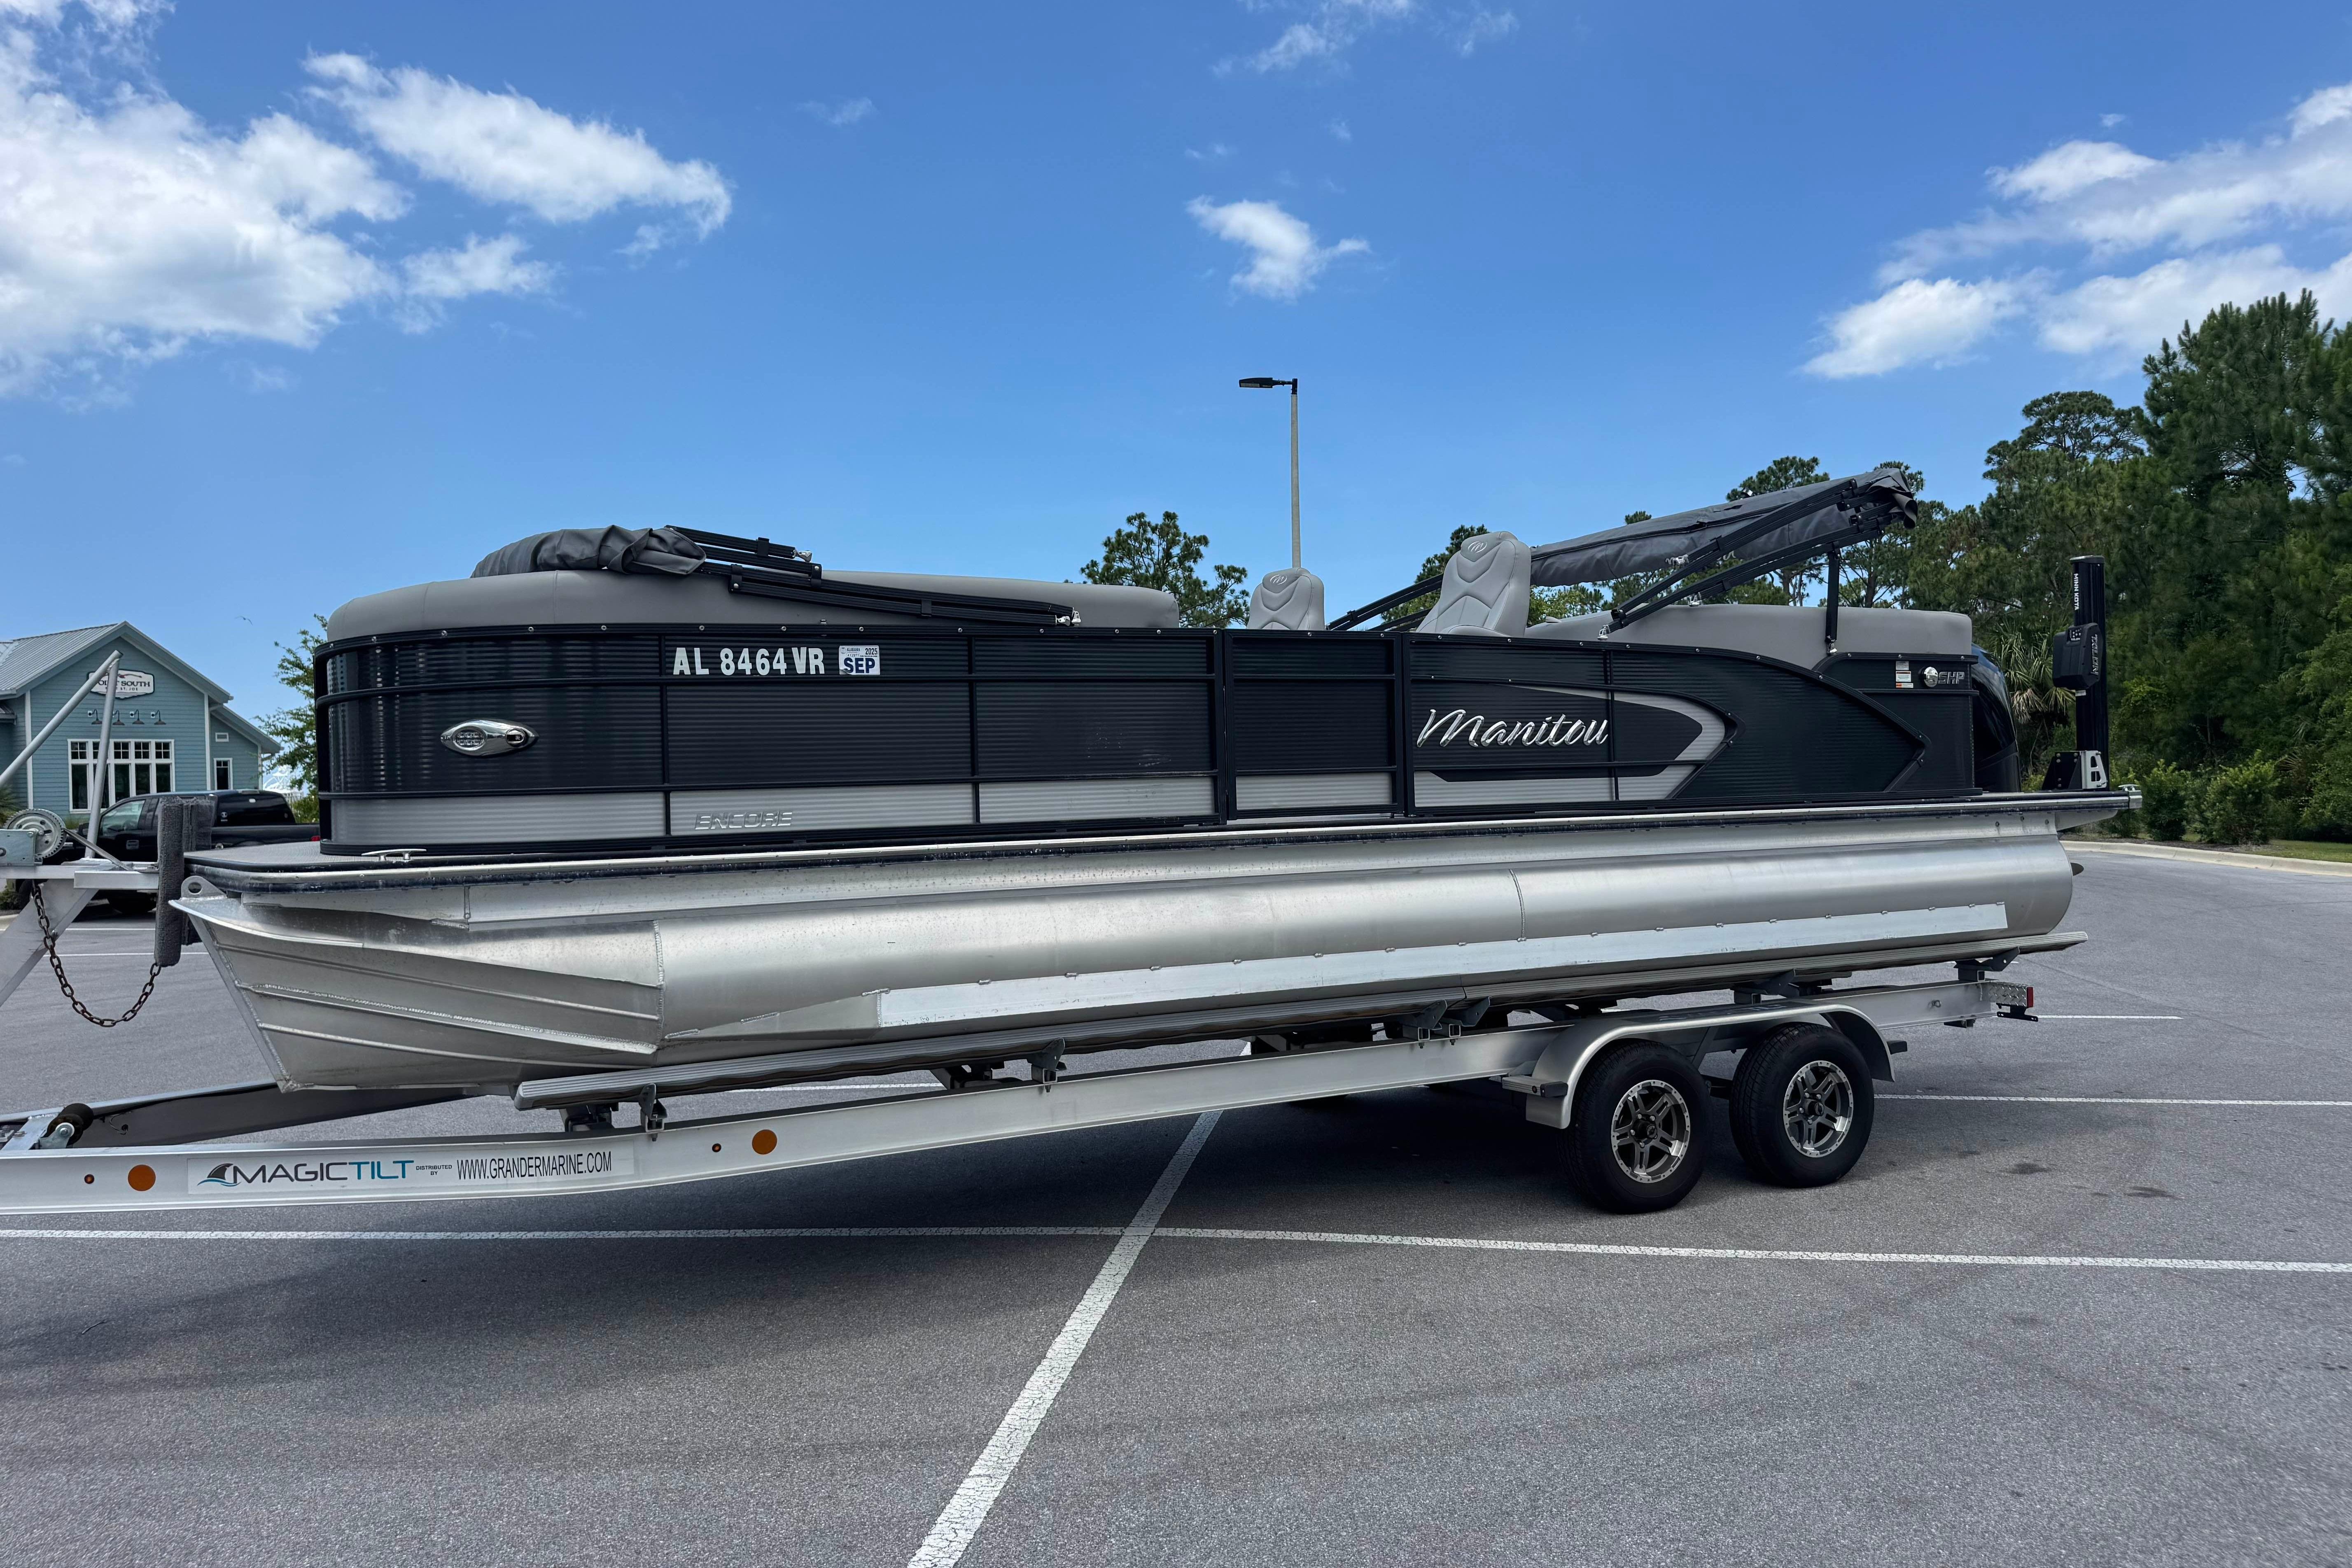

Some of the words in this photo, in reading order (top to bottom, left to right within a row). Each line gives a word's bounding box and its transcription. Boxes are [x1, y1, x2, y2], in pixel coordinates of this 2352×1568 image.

[673, 647, 709, 675] AL
[844, 657, 875, 674] SEP
[1938, 672, 1965, 684] SHP
[1416, 709, 1608, 748] Manitou
[695, 811, 793, 830] ENCORE
[233, 1160, 414, 1184] MAGICTILT
[457, 1151, 611, 1180] WWW.GRANDERMARINE.COM
